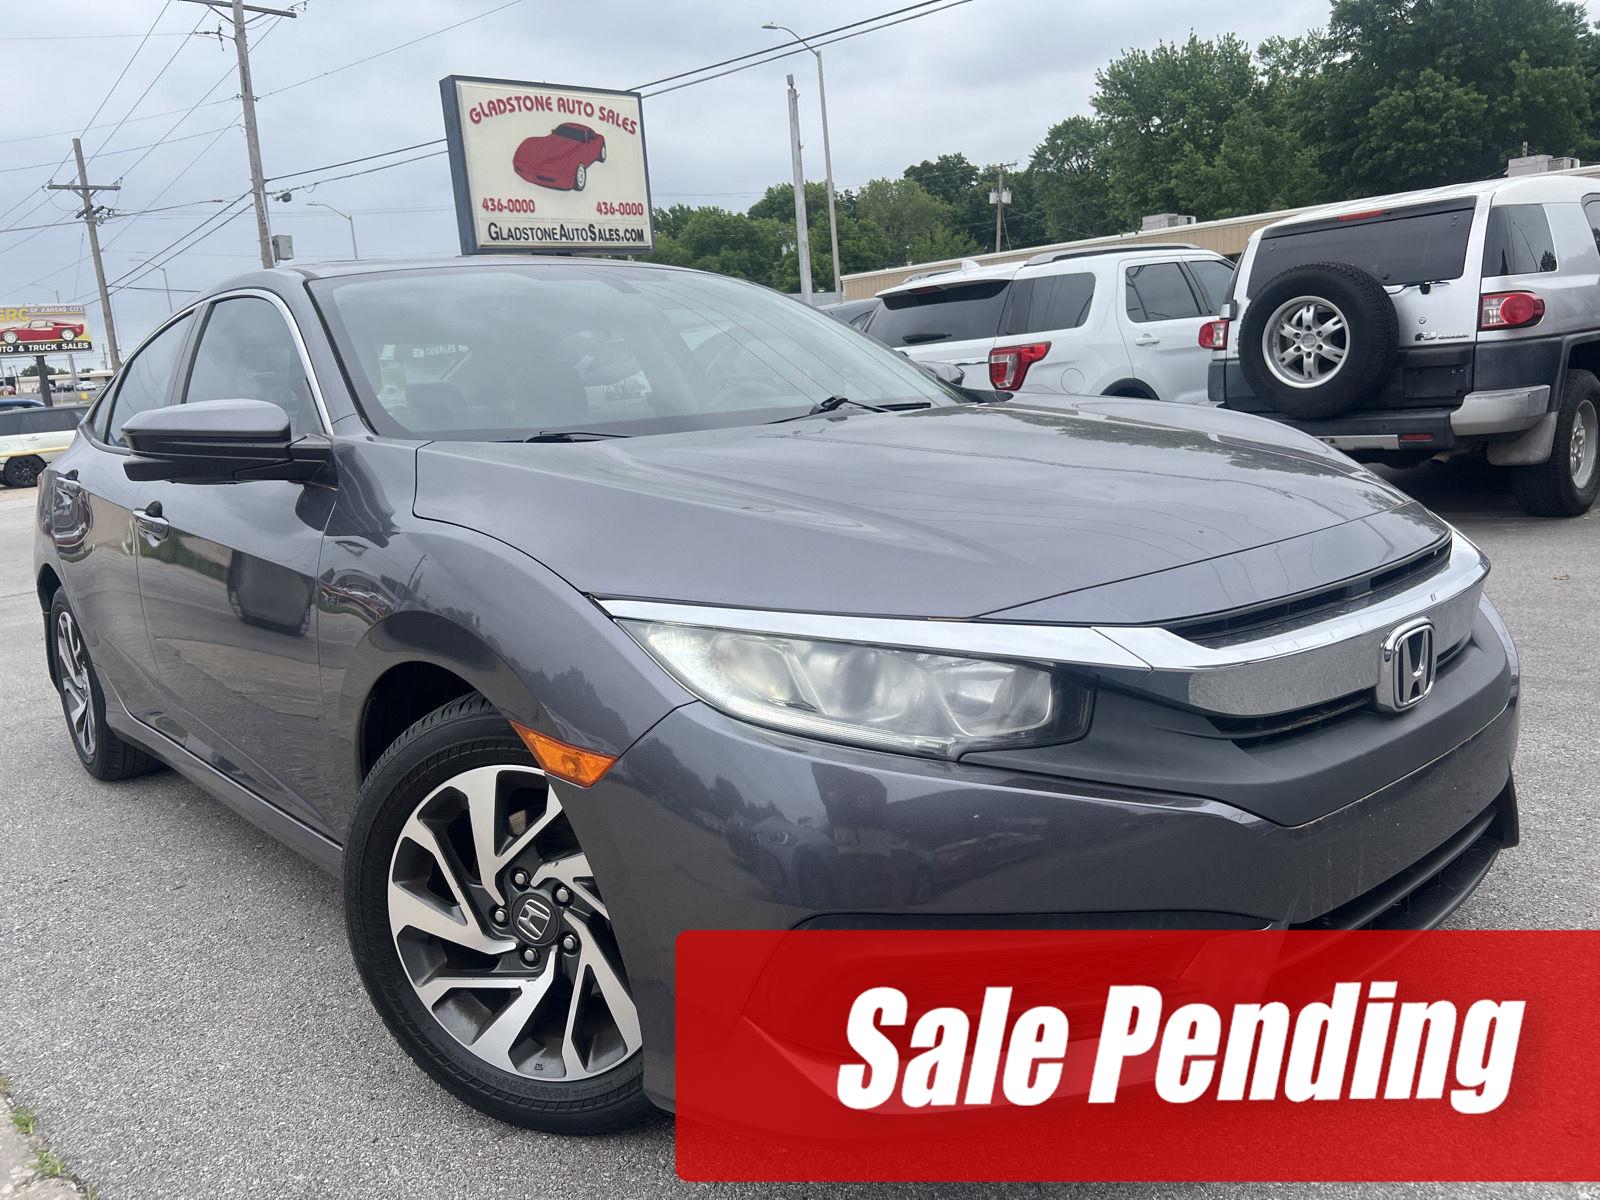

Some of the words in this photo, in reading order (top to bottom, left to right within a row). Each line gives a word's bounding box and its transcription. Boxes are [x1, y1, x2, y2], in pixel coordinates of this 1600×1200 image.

[470, 95, 552, 124] GLADSTONE
[558, 97, 594, 117] AUTO
[599, 106, 637, 135] SALES
[482, 197, 535, 213] 436-0000
[596, 201, 644, 216] 436-0000
[28, 343, 58, 351] TRUCK
[61, 342, 89, 350] SALES
